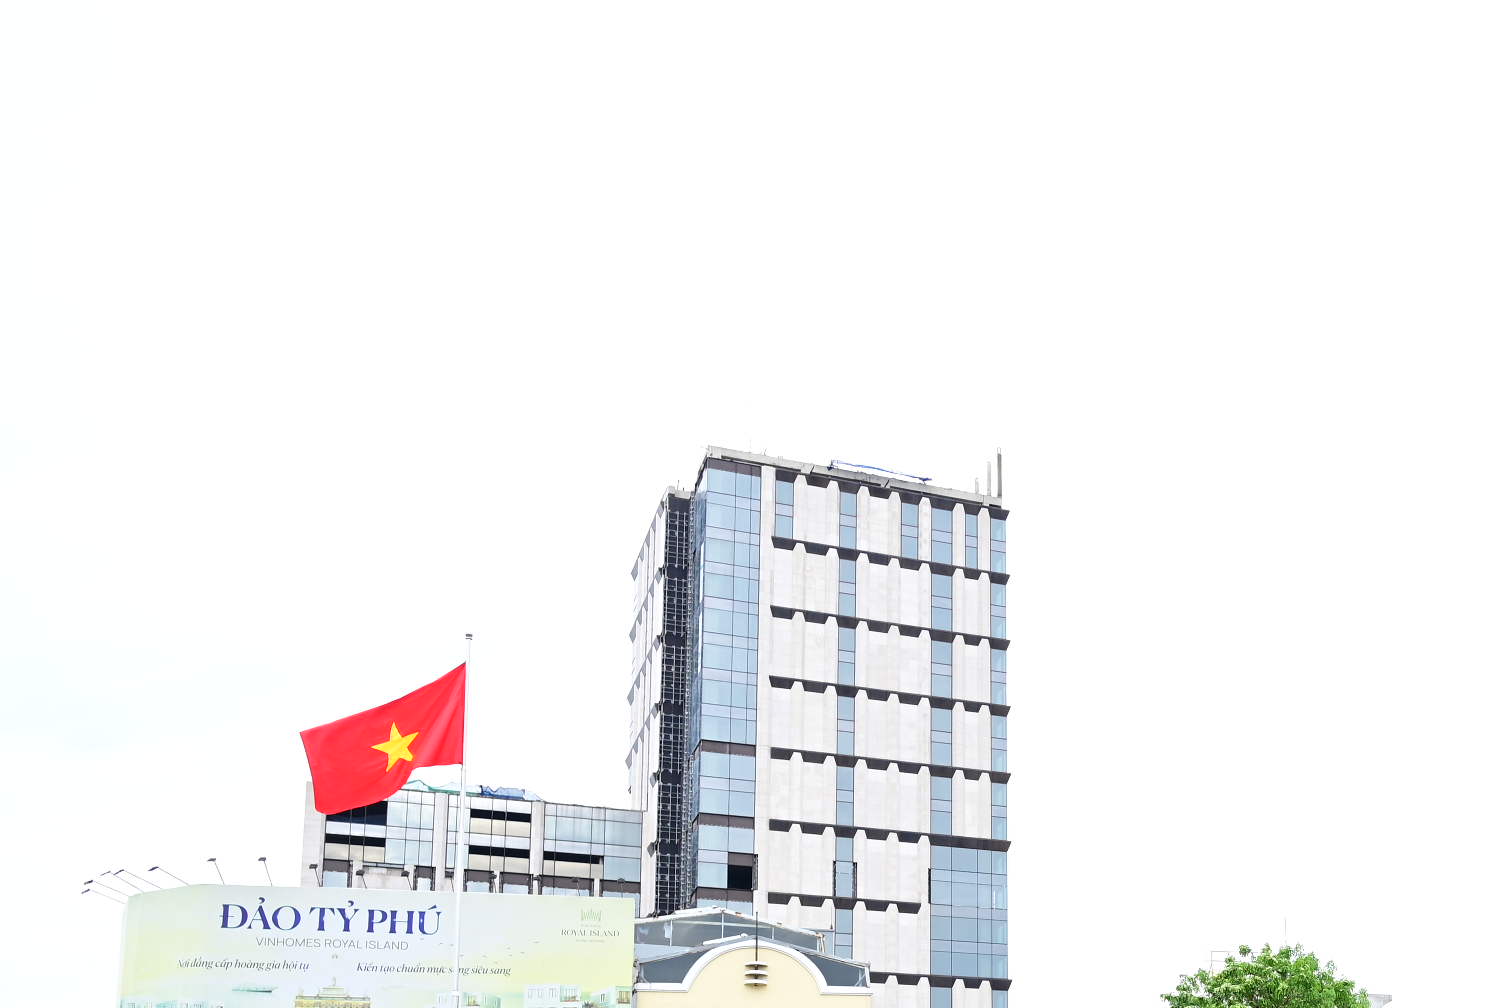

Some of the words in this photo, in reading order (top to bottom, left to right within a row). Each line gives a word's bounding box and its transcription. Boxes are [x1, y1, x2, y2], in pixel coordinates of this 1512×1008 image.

[219, 897, 302, 931] ĐẢO
[309, 900, 360, 932] TỶ
[366, 904, 442, 936] PHÚ
[561, 928, 587, 937] ROYAL
[255, 937, 321, 948] VINHOMES
[324, 938, 362, 950] ROYAL
[365, 940, 409, 951] ISLAND
[448, 965, 470, 976] sng
